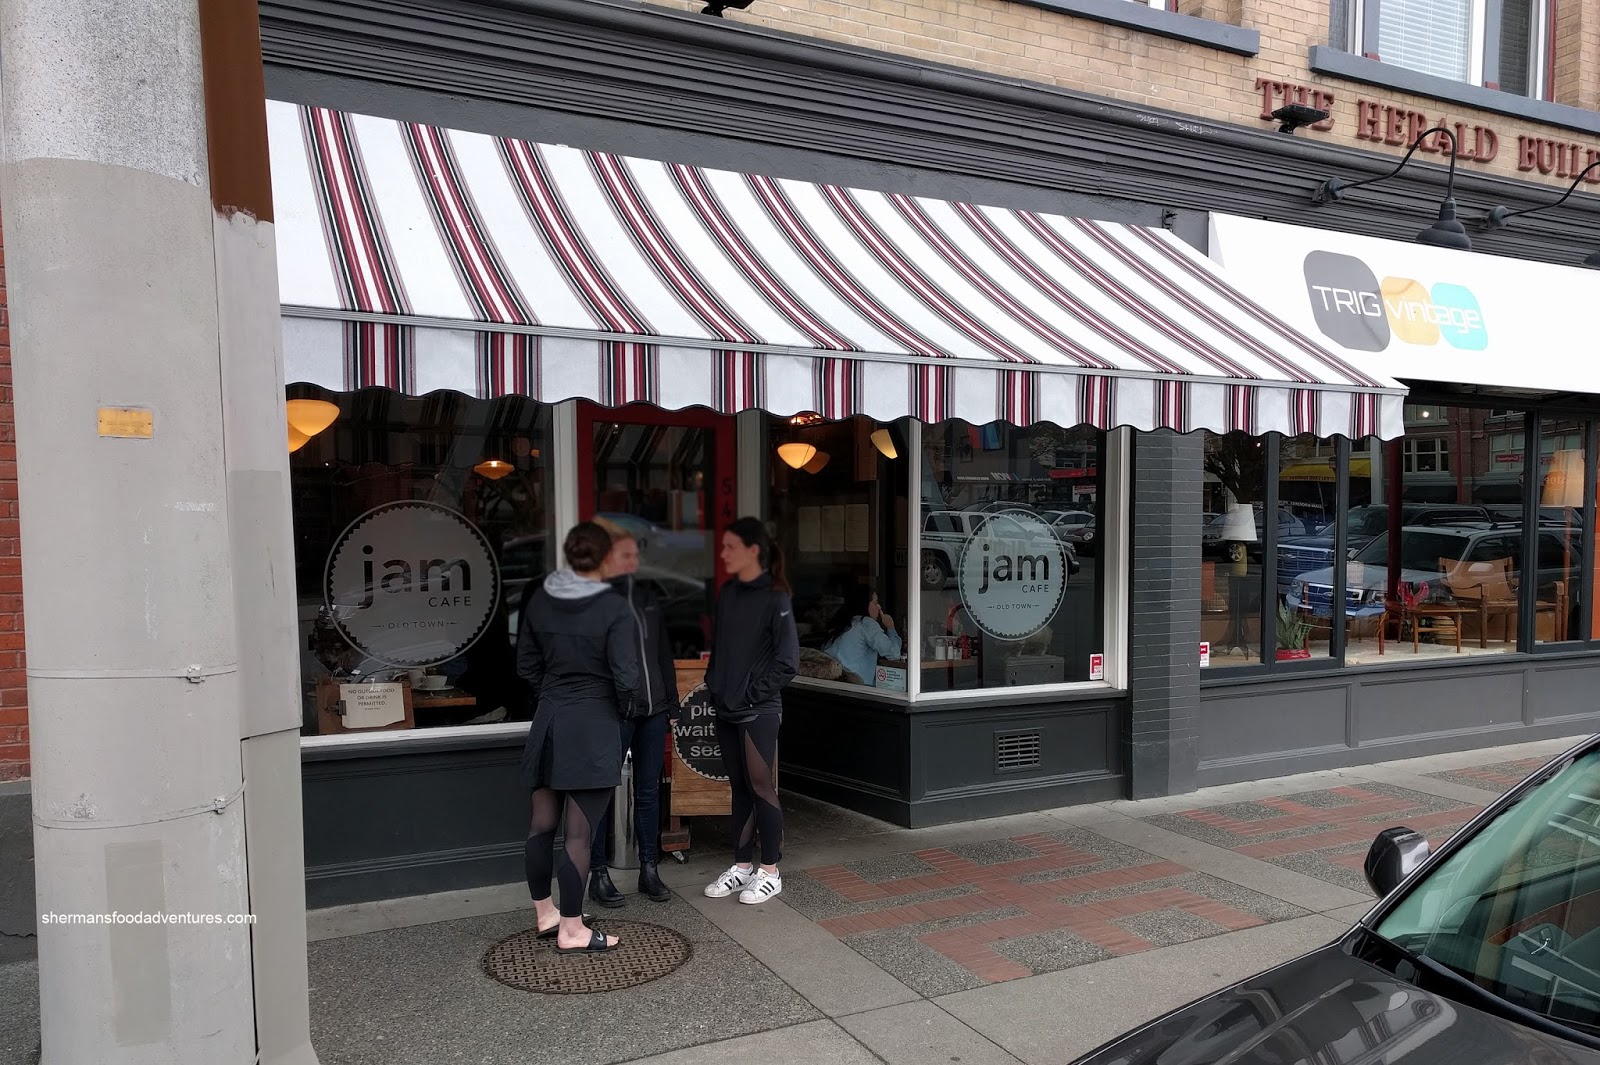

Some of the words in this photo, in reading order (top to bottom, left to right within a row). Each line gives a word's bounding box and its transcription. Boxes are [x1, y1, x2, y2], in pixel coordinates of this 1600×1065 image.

[1256, 78, 1335, 131] THE
[1357, 99, 1499, 163] HERALD
[1312, 285, 1382, 317] TRIG
[1386, 297, 1482, 334] vintage
[978, 543, 1049, 595] jam
[358, 545, 472, 610] jam
[1022, 584, 1049, 594] CAFE
[428, 596, 472, 608] CAFE
[412, 620, 444, 628] TOWN
[691, 702, 716, 720] ple
[676, 722, 715, 737] wait
[690, 744, 722, 757] sea
